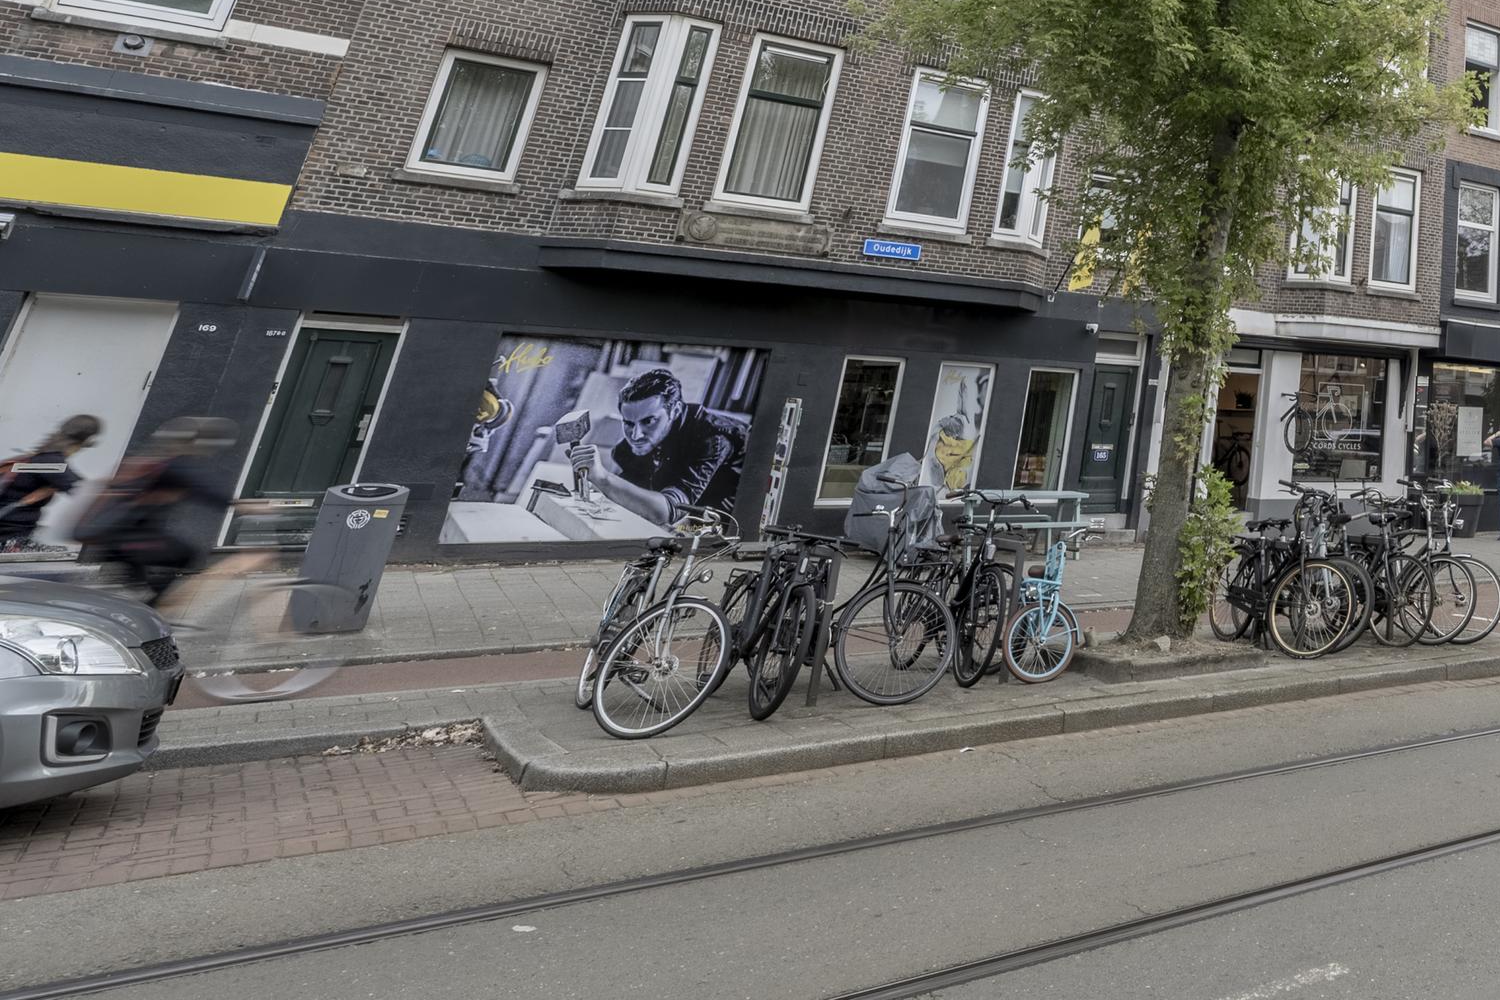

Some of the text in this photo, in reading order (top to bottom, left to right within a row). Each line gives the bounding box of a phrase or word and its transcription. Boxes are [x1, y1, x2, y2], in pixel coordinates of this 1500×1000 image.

[873, 243, 912, 256] Oudedijk
[198, 324, 217, 332] 169
[1338, 442, 1361, 450] CYCLES
